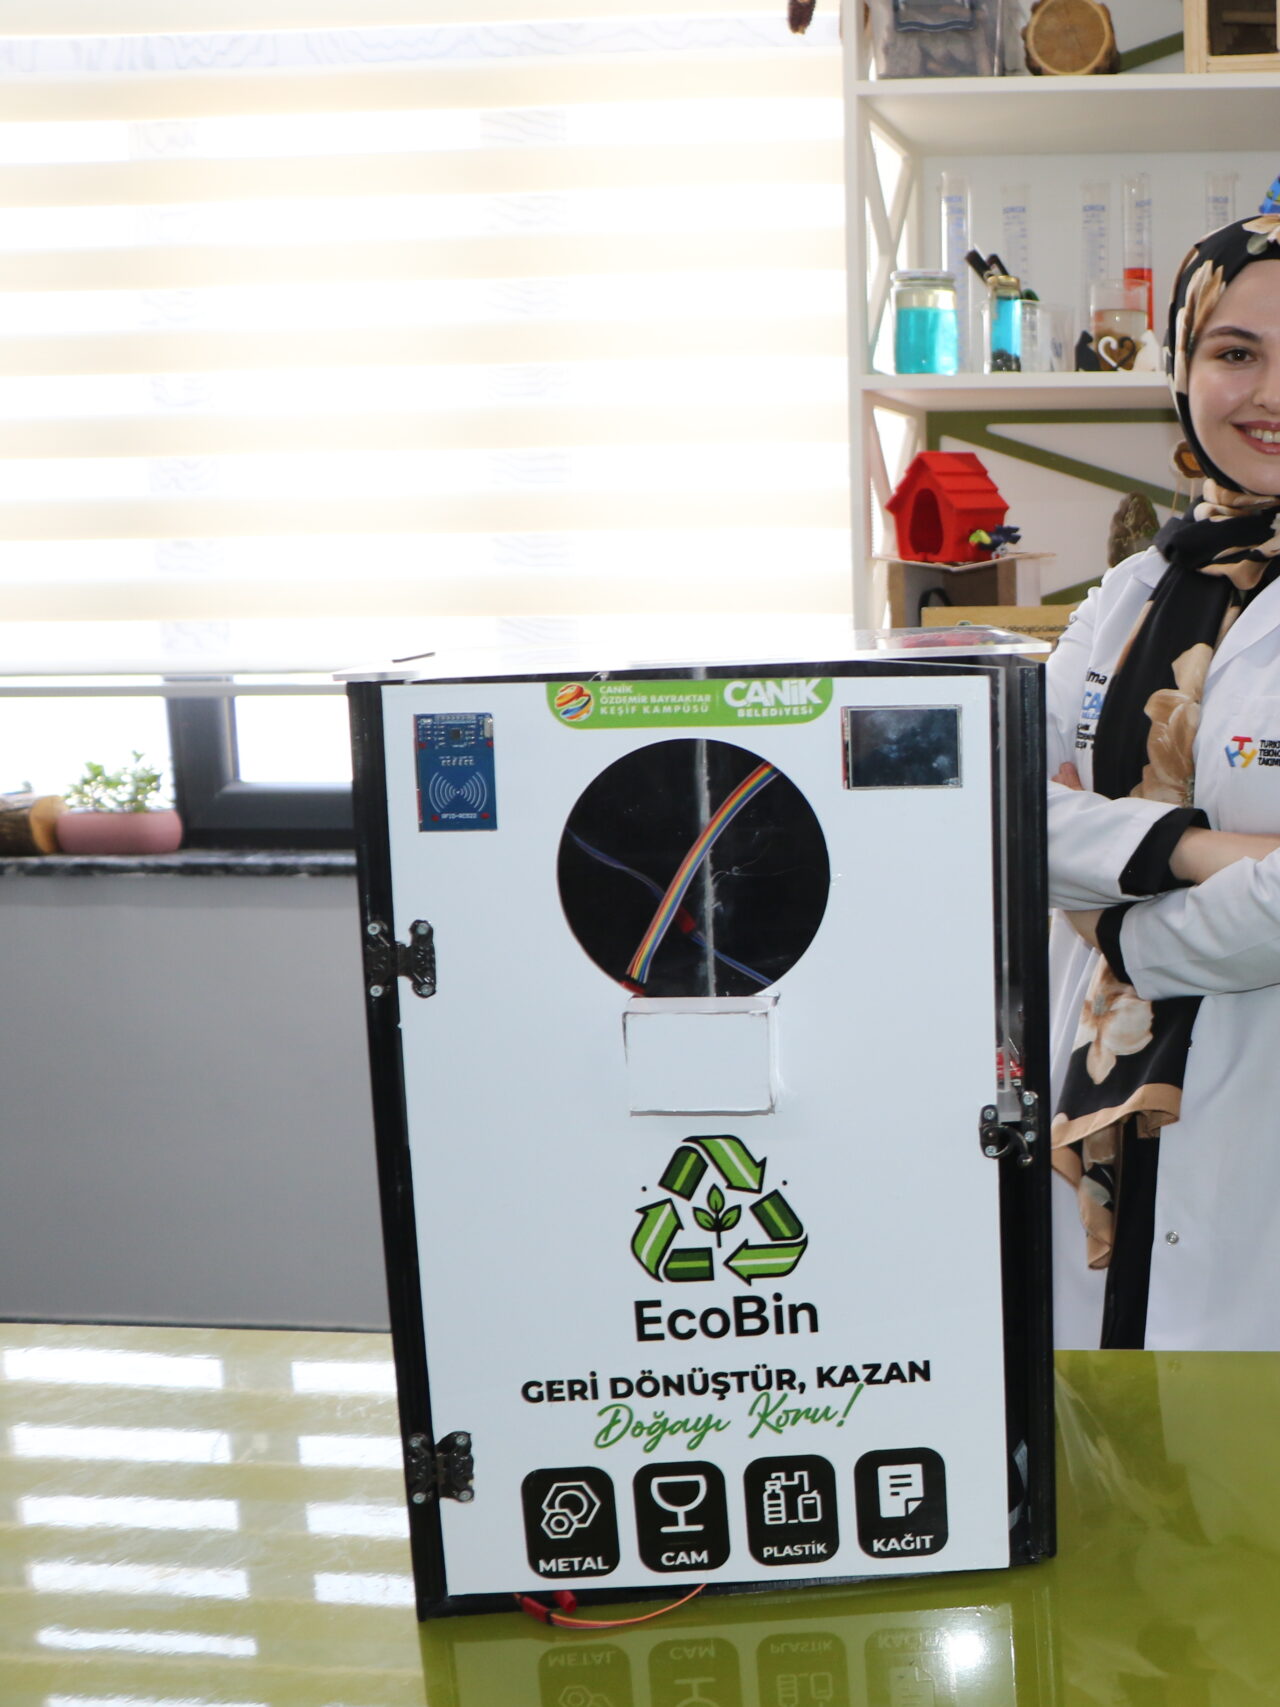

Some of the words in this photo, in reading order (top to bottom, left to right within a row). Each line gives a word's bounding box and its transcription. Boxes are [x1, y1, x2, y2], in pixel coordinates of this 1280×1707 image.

[650, 694, 711, 704] BAYRAKTAR
[723, 679, 823, 708] CANİK
[600, 705, 638, 716] KEŞİF
[643, 703, 709, 715] KAMPÜSÜ
[737, 707, 814, 718] BELEDİYESİ
[633, 1292, 819, 1342] EcoBin
[521, 1371, 599, 1403] GERİ
[609, 1363, 806, 1401] DÖNÜŞTÜR,
[816, 1360, 931, 1388] KAZAN
[594, 1403, 731, 1453] Doğayı
[762, 1540, 828, 1558] PLASTİK
[872, 1533, 934, 1552] KAĞIT
[538, 1556, 609, 1574] METAL
[660, 1550, 709, 1567] CAM
